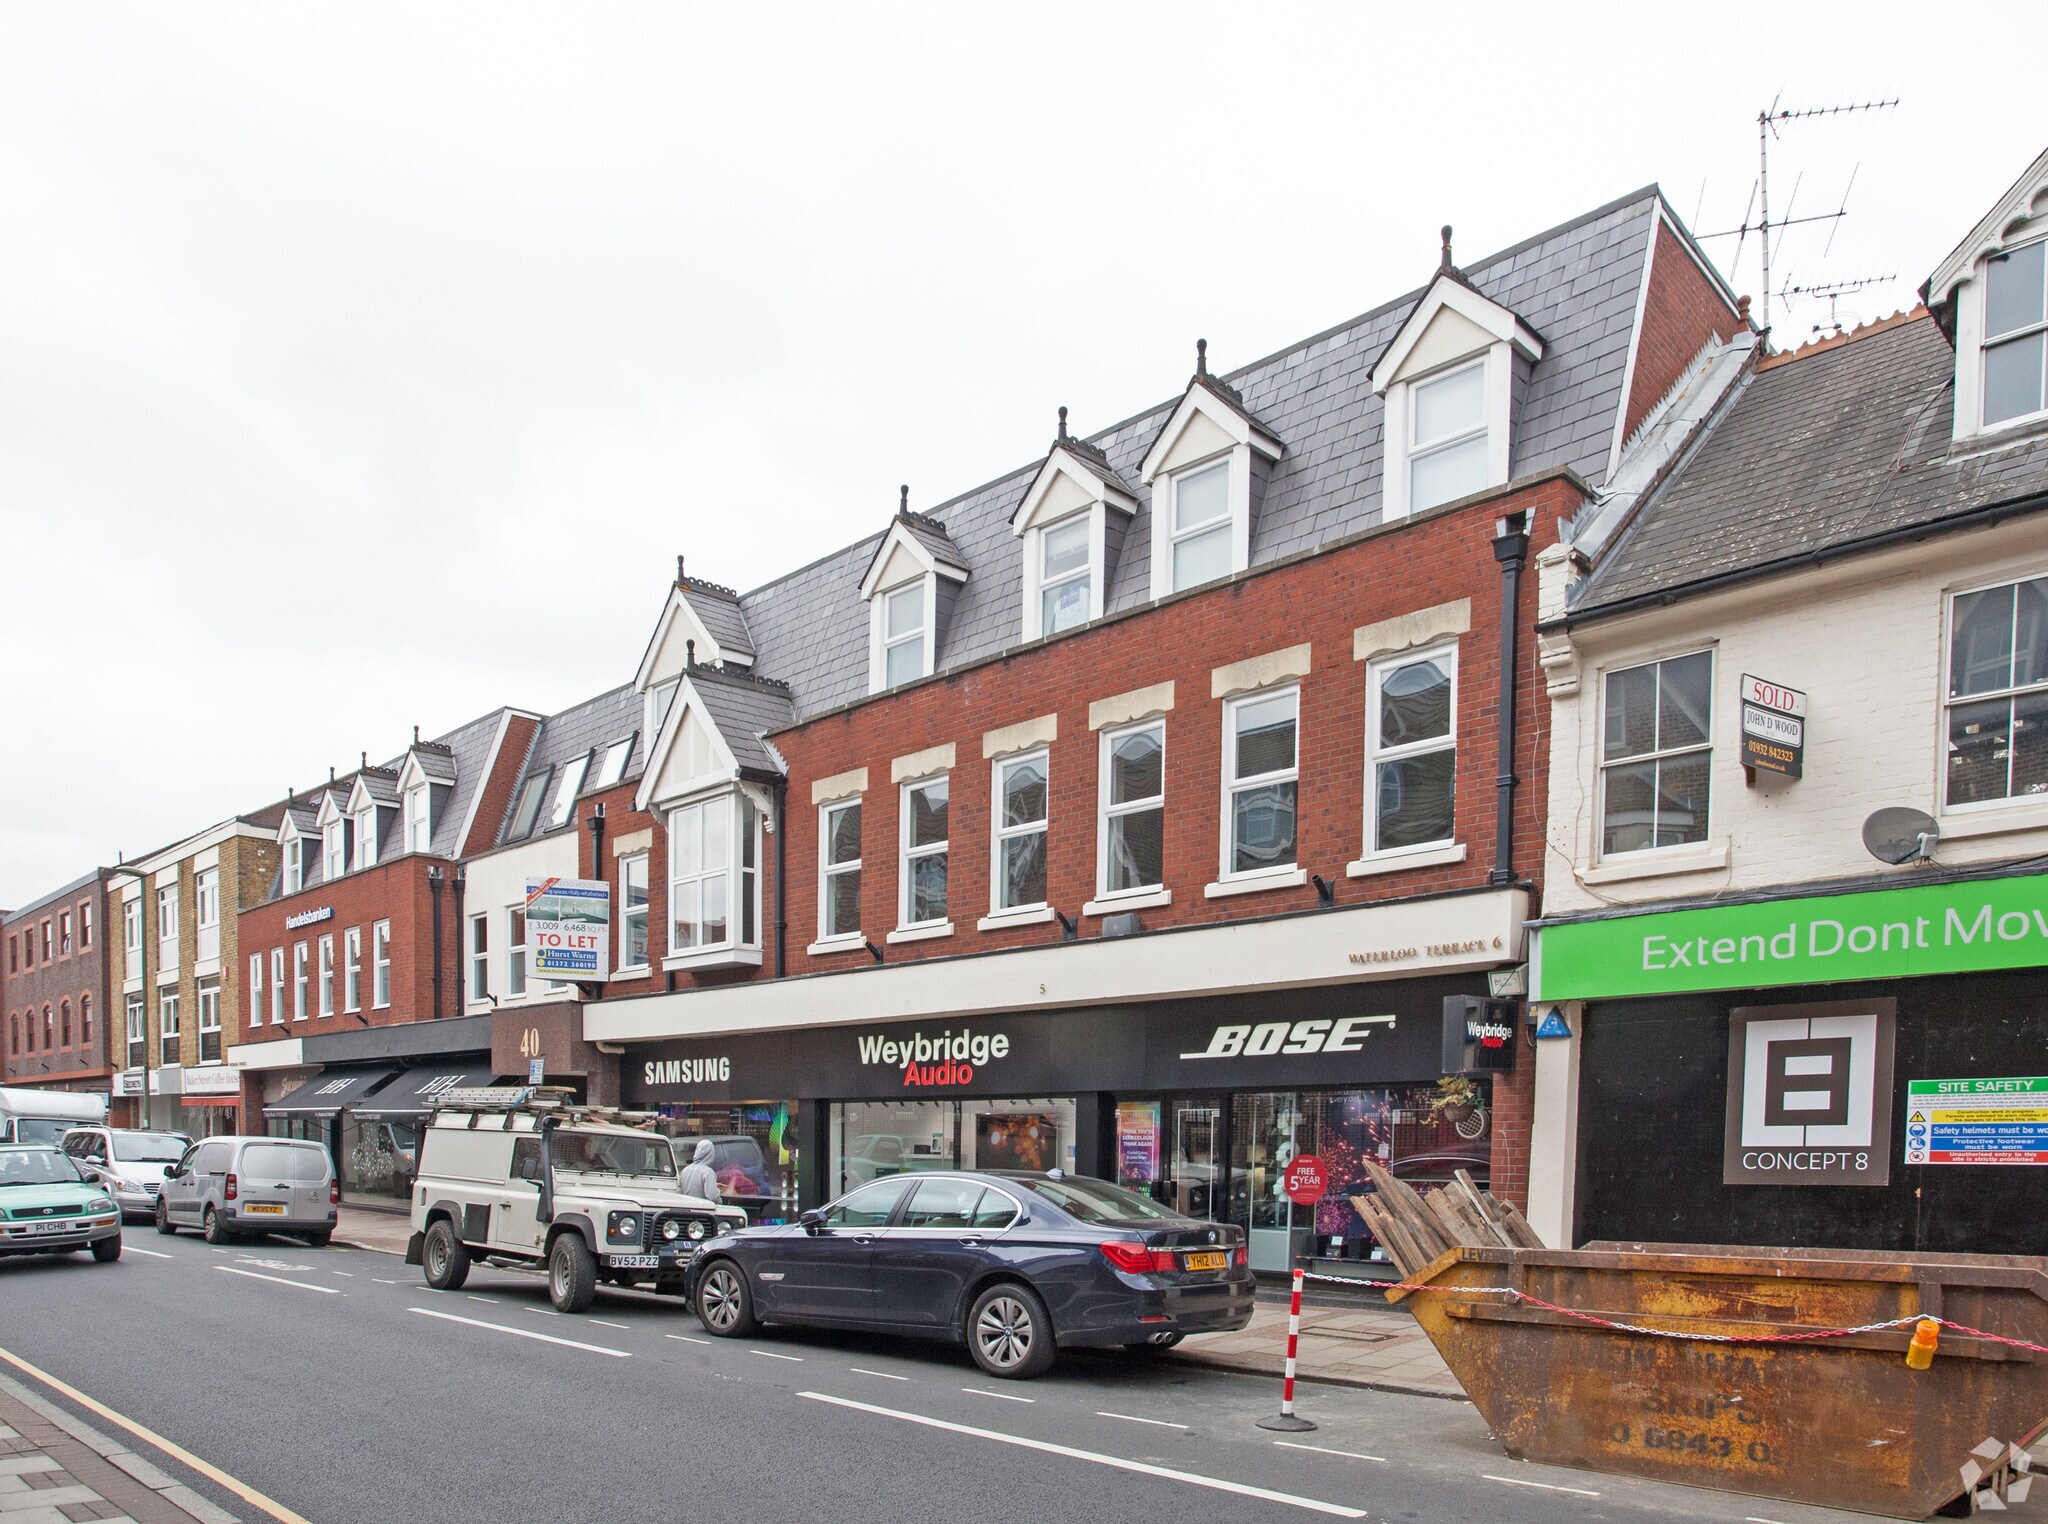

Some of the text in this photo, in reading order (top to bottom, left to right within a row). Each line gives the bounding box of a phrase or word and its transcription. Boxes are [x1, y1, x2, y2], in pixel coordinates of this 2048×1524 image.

[1753, 682, 1794, 711] SOLD
[1747, 711, 1798, 736] JOHN D WOOD
[1748, 740, 1793, 762] 01932 842323
[286, 906, 331, 930] Handelsbanken
[536, 921, 559, 931] 3,009
[564, 923, 586, 932] 6,468
[536, 933, 598, 949] TO LET
[1642, 904, 2048, 970] Extend Dont Mov
[547, 950, 596, 960] Hurst Warne
[1348, 935, 1502, 964] WATERLOO TERRACE 6
[1039, 983, 1046, 995] 5
[1180, 1015, 1396, 1059] BOSE
[1467, 1021, 1512, 1040] Weybridge
[520, 1028, 540, 1057] 40
[858, 1029, 1009, 1069] Weybridge
[1481, 1036, 1504, 1048] Audio
[187, 1074, 198, 1086] Baker
[199, 1074, 211, 1085] Street
[212, 1073, 225, 1084] Coffee
[645, 1057, 730, 1085] SAMSUNG
[903, 1059, 973, 1087] Audio
[123, 1079, 142, 1089] SECRETS
[314, 1077, 358, 1095] HH
[1938, 1080, 2034, 1092] SITE SAFETY
[1933, 1126, 1960, 1136] Safety
[1962, 1126, 1996, 1134] helmets
[1998, 1126, 2020, 1134] must
[2022, 1125, 2034, 1134] be
[1742, 1152, 1868, 1171] CONCEPT 8
[1296, 1167, 1315, 1175] FREE
[1290, 1175, 1320, 1191] 5 YEAR
[47, 1222, 67, 1230] CHB
[610, 1256, 659, 1267] BV52 PZZ
[1190, 1254, 1225, 1268] YH12 ALU
